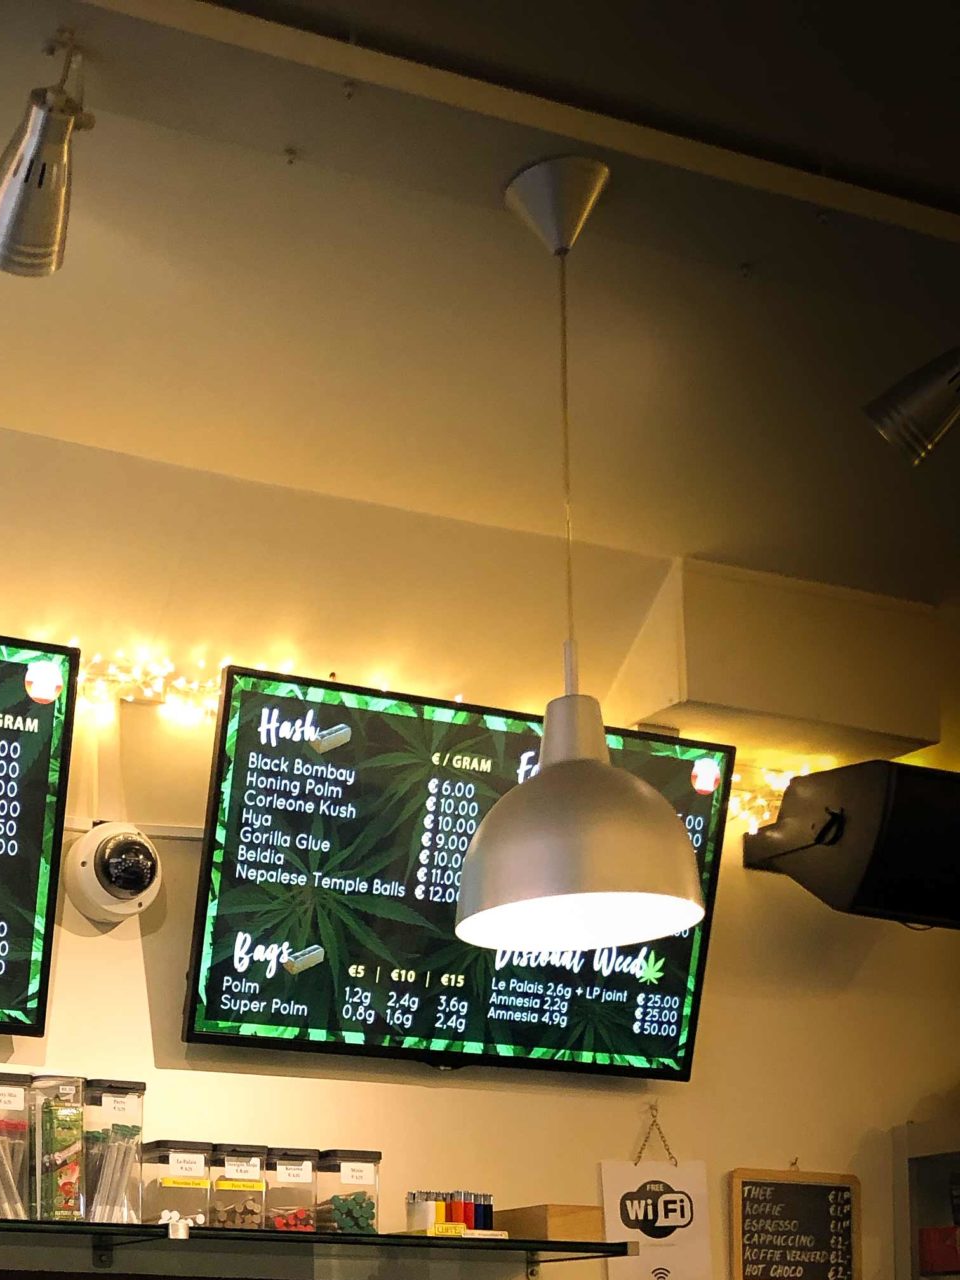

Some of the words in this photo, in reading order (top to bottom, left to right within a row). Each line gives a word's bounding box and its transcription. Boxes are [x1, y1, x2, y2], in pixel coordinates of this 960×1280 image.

[258, 706, 321, 747] Hash
[248, 752, 288, 772] Black
[294, 758, 356, 785] Bombay
[453, 756, 491, 773] GRAM
[246, 771, 300, 796] Honing
[306, 780, 342, 799] Polm
[442, 780, 475, 799] 6.00
[244, 790, 314, 814] Corleone
[319, 801, 356, 819] Kush
[440, 799, 478, 817] 10.00
[242, 810, 272, 828] Hya
[438, 817, 476, 835] 10.00
[240, 827, 290, 848] Gorilla
[296, 835, 331, 852] Glue
[436, 834, 468, 851] 9.00
[238, 845, 285, 865] Beldia
[433, 852, 465, 868] 10.0
[235, 865, 307, 887] Nepalese
[312, 872, 368, 894] Temple
[373, 880, 406, 897] Balls
[234, 931, 291, 978] Bags
[348, 964, 366, 978] €5
[391, 968, 416, 983] €10
[441, 973, 465, 987] €15
[222, 976, 260, 994] Polm
[492, 977, 507, 991] Le
[510, 978, 544, 994] Palais
[547, 983, 572, 999] 2,6g
[586, 986, 600, 999] LP
[602, 990, 627, 1004] joint
[221, 994, 267, 1014] Super
[272, 999, 308, 1016] Polm
[345, 986, 372, 1006] 1,2g
[387, 992, 419, 1011] 2,4g
[438, 995, 468, 1015] 3,6g
[489, 992, 540, 1008] Amnesia
[543, 997, 568, 1013] 2,2g
[648, 994, 679, 1008] 25.00
[342, 1004, 375, 1024] 0,8g
[386, 1010, 413, 1029] 1,6g
[435, 1014, 466, 1033] 2,4g
[487, 1007, 538, 1023] Amnesia
[541, 1012, 568, 1028] 4,9g
[646, 1009, 678, 1022] 25.00
[643, 1023, 677, 1037] 50.00
[646, 1183, 664, 1192] FREE
[743, 1185, 774, 1200] THEE
[745, 1202, 784, 1216] KOFFIE
[744, 1219, 799, 1232] ESPRESSO
[743, 1233, 815, 1246] CAPPUCCINO
[744, 1247, 783, 1261] KOFFIE
[745, 1264, 766, 1277] HOT
[770, 1264, 803, 1278] CHOCO
